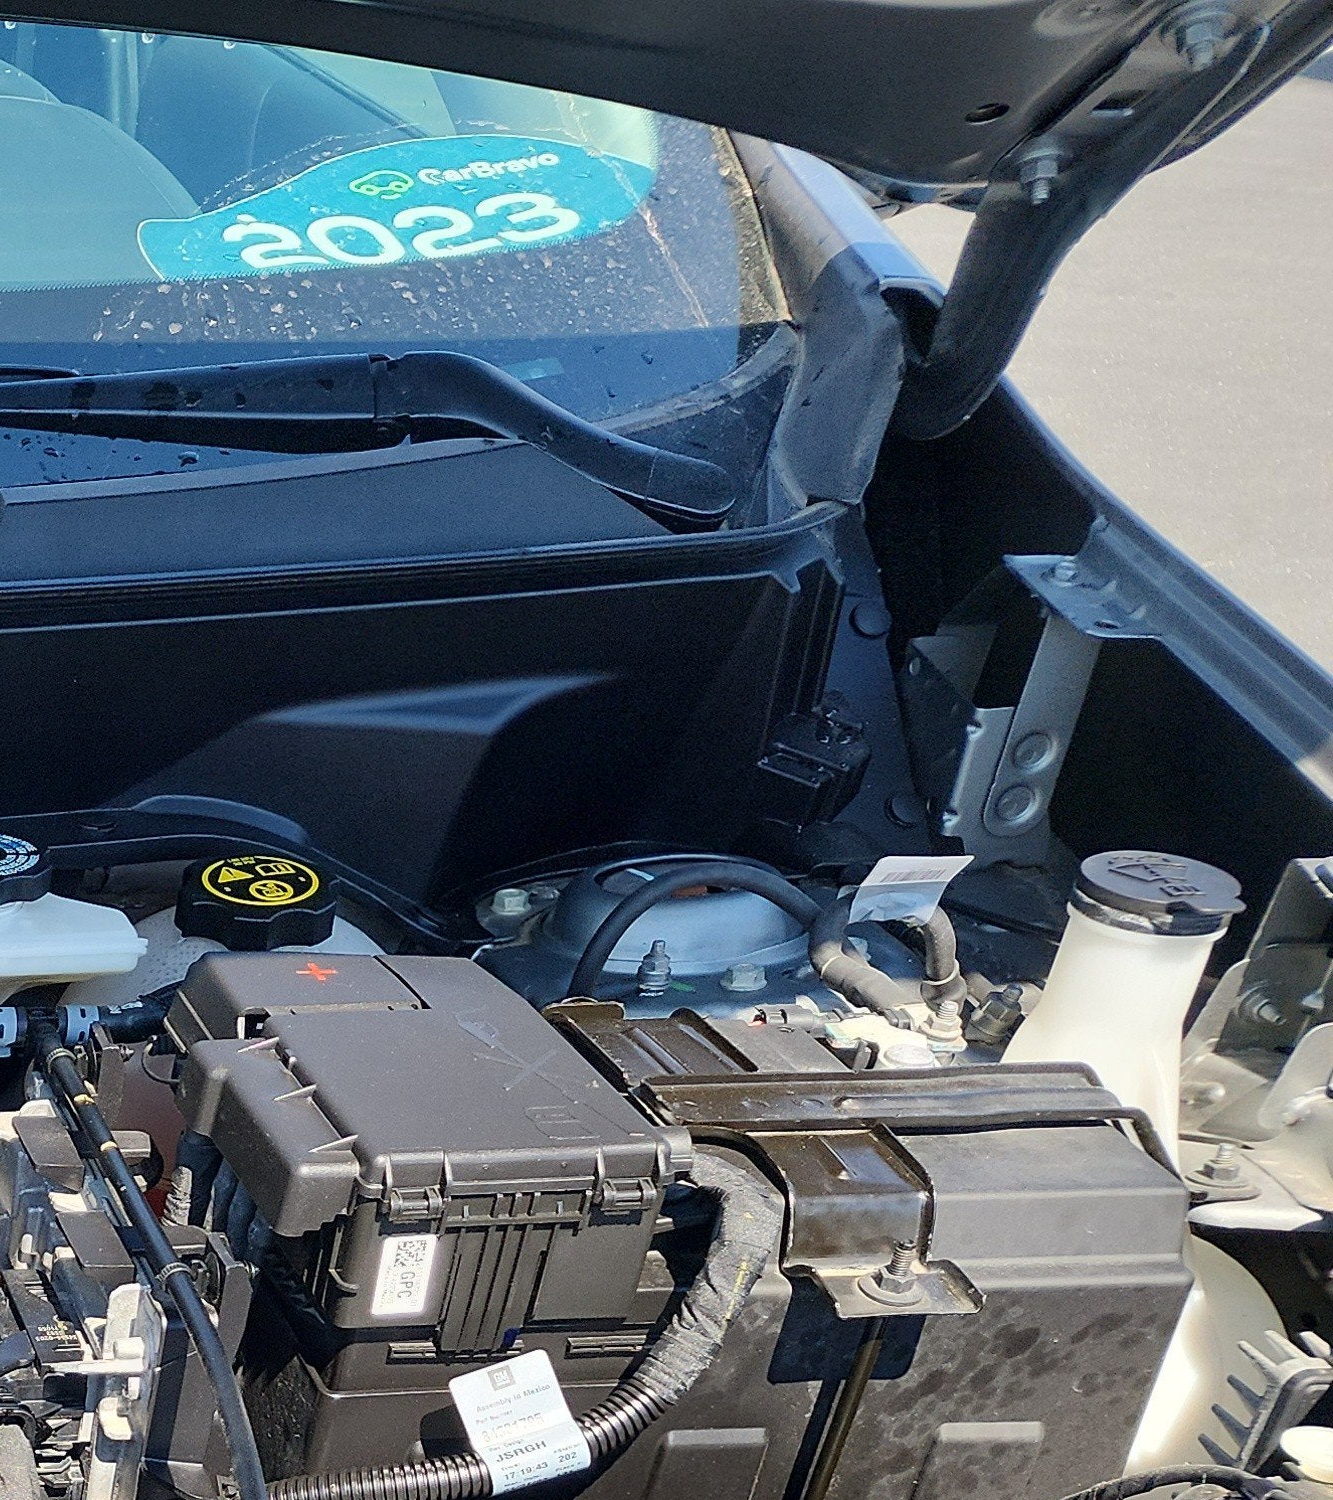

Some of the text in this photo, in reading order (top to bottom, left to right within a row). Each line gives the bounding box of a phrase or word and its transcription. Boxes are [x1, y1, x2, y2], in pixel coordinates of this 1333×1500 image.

[418, 150, 561, 187] CarBravo
[222, 192, 582, 268] 2023
[397, 1271, 416, 1299] GPC
[495, 1440, 547, 1463] JSRGH
[558, 1451, 578, 1463] 202
